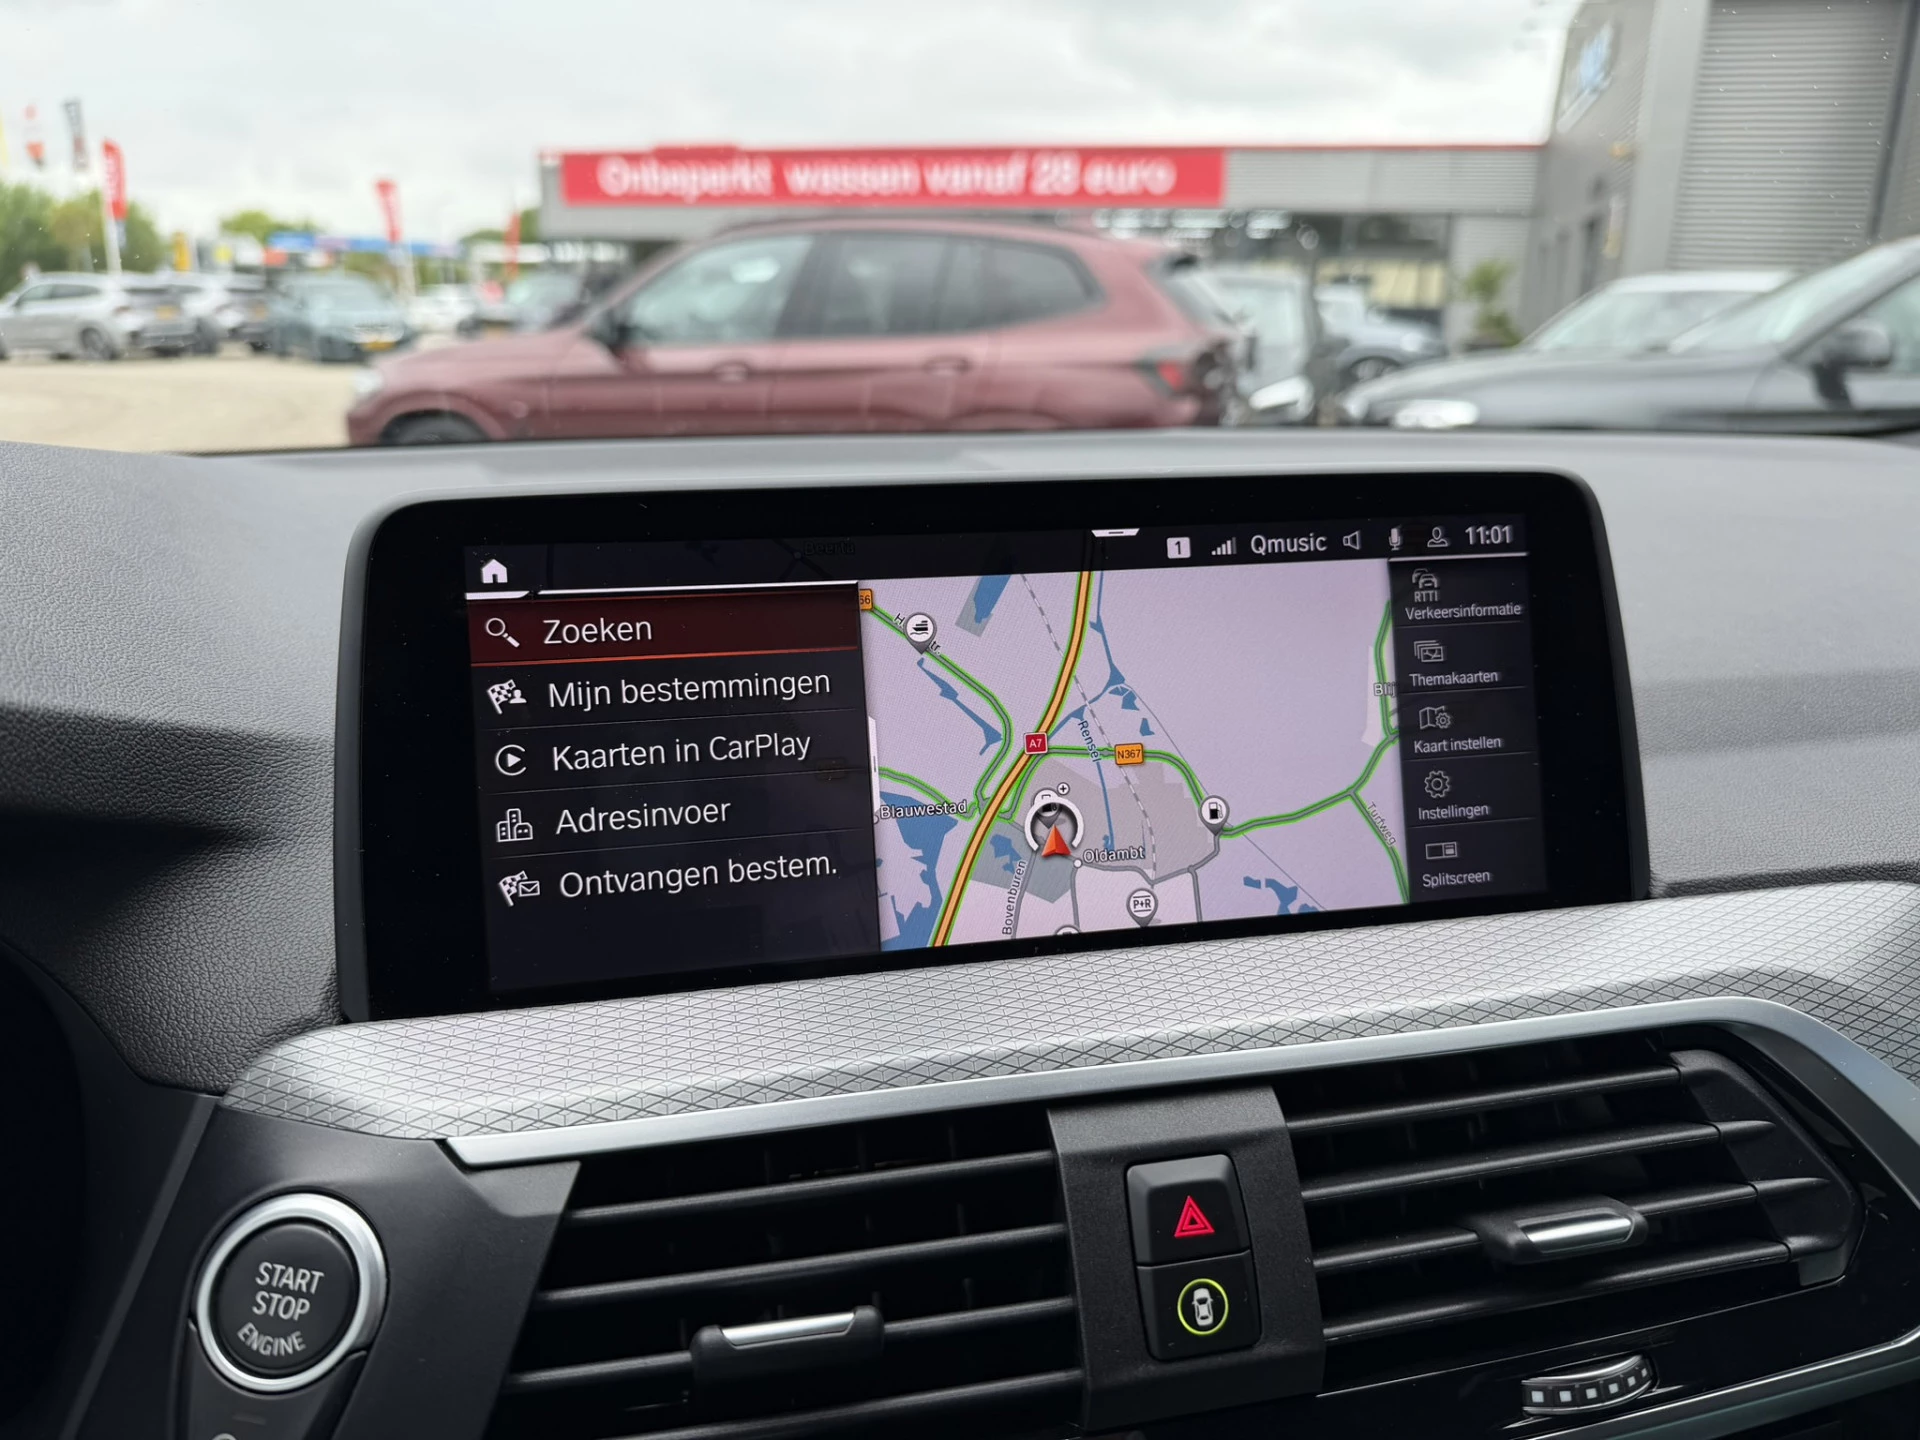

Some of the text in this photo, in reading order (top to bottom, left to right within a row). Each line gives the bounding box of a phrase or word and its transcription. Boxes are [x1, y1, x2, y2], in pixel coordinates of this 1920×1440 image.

[783, 159, 920, 197] wassen
[922, 152, 1030, 196] vanaf
[1083, 157, 1177, 196] euro
[1250, 533, 1328, 554] Qmusic
[1464, 525, 1514, 545] 11:01
[1413, 590, 1439, 602] RTTI
[1405, 602, 1522, 620] Verkeersinformatie
[543, 617, 653, 645] Zoeken
[1409, 670, 1499, 687] Themakaarten
[548, 672, 831, 712] Mijn bestemmingen
[553, 732, 812, 772] Kaarten in CarPlay
[1028, 737, 1043, 749] A7
[1078, 720, 1102, 763] Rensel
[1413, 735, 1502, 754] Kaart instellen
[1117, 749, 1141, 760] N367
[555, 801, 731, 835] Adresinvoer
[880, 799, 967, 820] Blauwestad
[1418, 802, 1490, 822] Instellingen
[1368, 801, 1396, 846] Turfweg
[1082, 846, 1146, 864] Oldambt
[559, 854, 838, 898] Ontvangen bestem.
[1422, 868, 1491, 888] Splitscreen
[1002, 859, 1027, 936] Bovenburen
[1133, 898, 1152, 910] P+R
[255, 1261, 324, 1295] START
[252, 1290, 310, 1321] STOP
[237, 1322, 306, 1356] ENGINE
